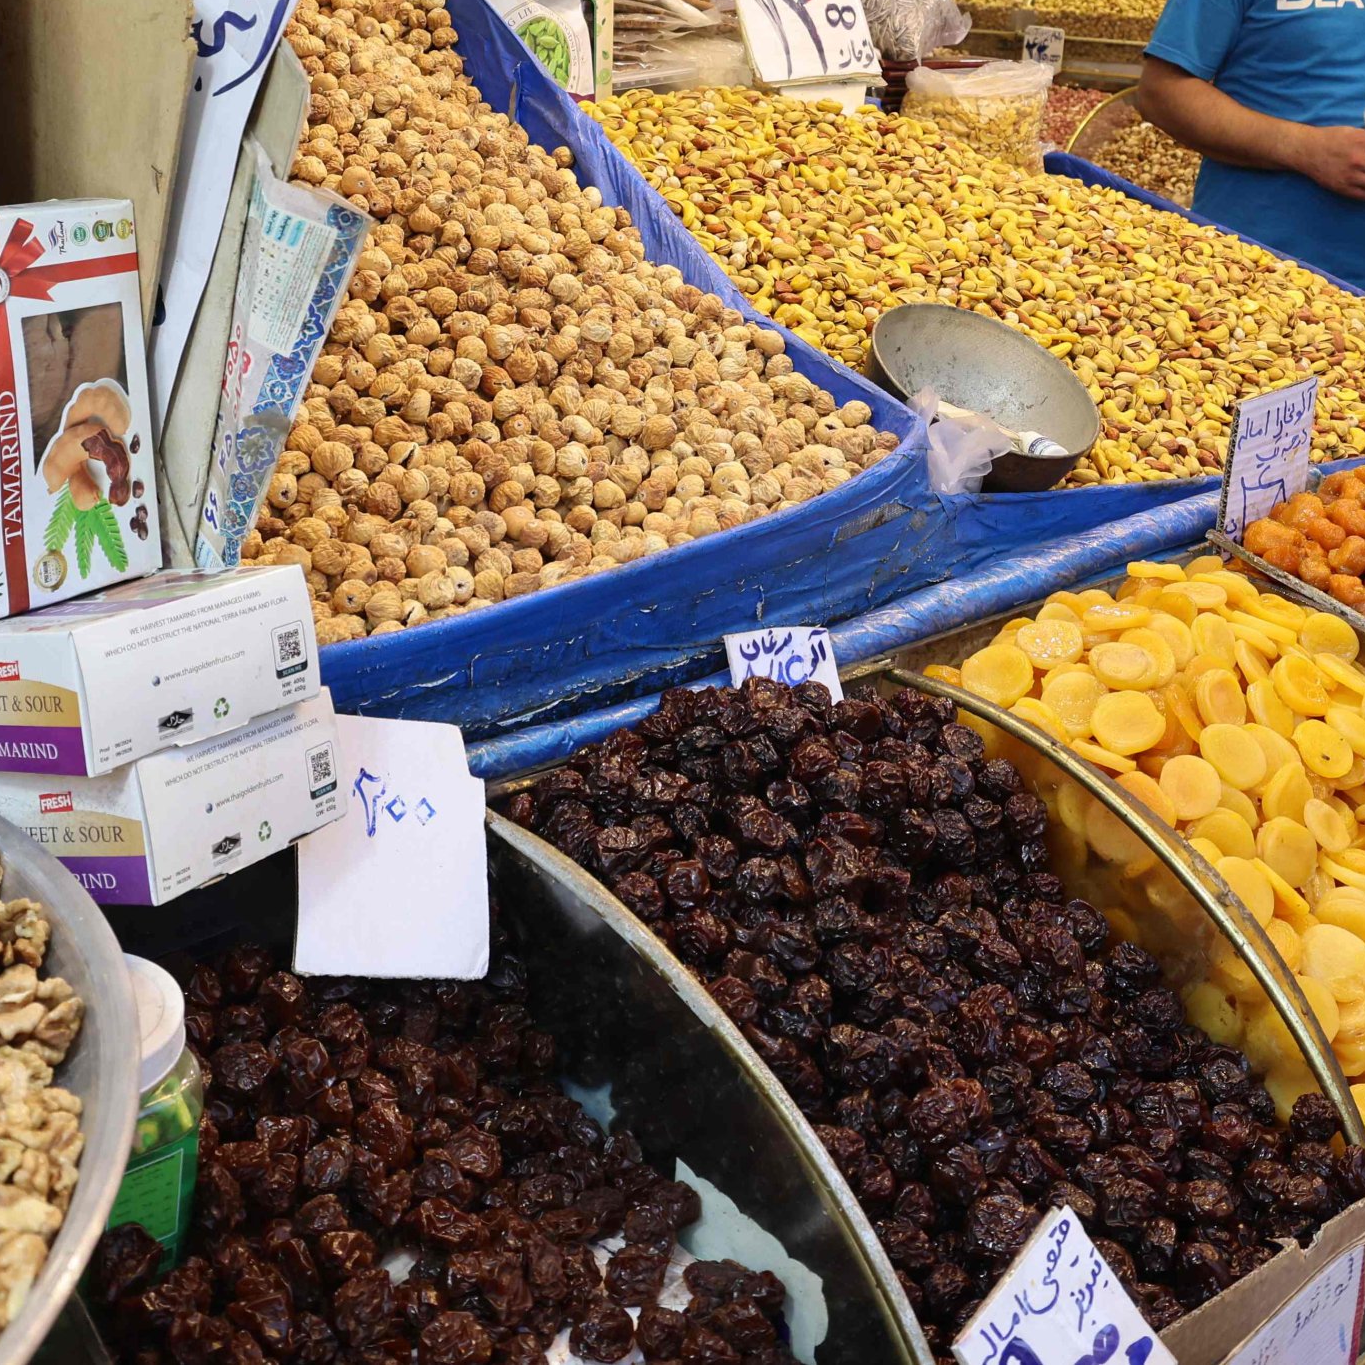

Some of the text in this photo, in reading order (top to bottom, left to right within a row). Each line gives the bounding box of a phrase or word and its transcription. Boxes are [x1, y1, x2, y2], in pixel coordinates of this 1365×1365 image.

[140, 619, 166, 634] HARVEST
[166, 611, 197, 626] TAMARIND
[197, 603, 216, 618] FROM
[214, 596, 243, 614] MANAGED
[104, 645, 127, 659] WHICH
[137, 637, 151, 649] NOT
[149, 629, 181, 646] DESTRUCT
[191, 618, 222, 634] NATIONAL
[221, 611, 239, 624] TERRA
[257, 600, 271, 612] AND
[163, 649, 246, 682] www.thaigoldenfruits.com
[11, 696, 23, 712] &
[25, 695, 64, 714] SOUR
[216, 739, 242, 754] TAMARIND
[241, 731, 257, 744] FROM
[204, 756, 230, 775] DESTRUCT
[215, 773, 284, 809] www.thaigoldenfruits.com
[40, 795, 72, 810] FRESH
[63, 826, 75, 843] &
[76, 825, 126, 843] SOUR
[75, 871, 117, 890] RIND
